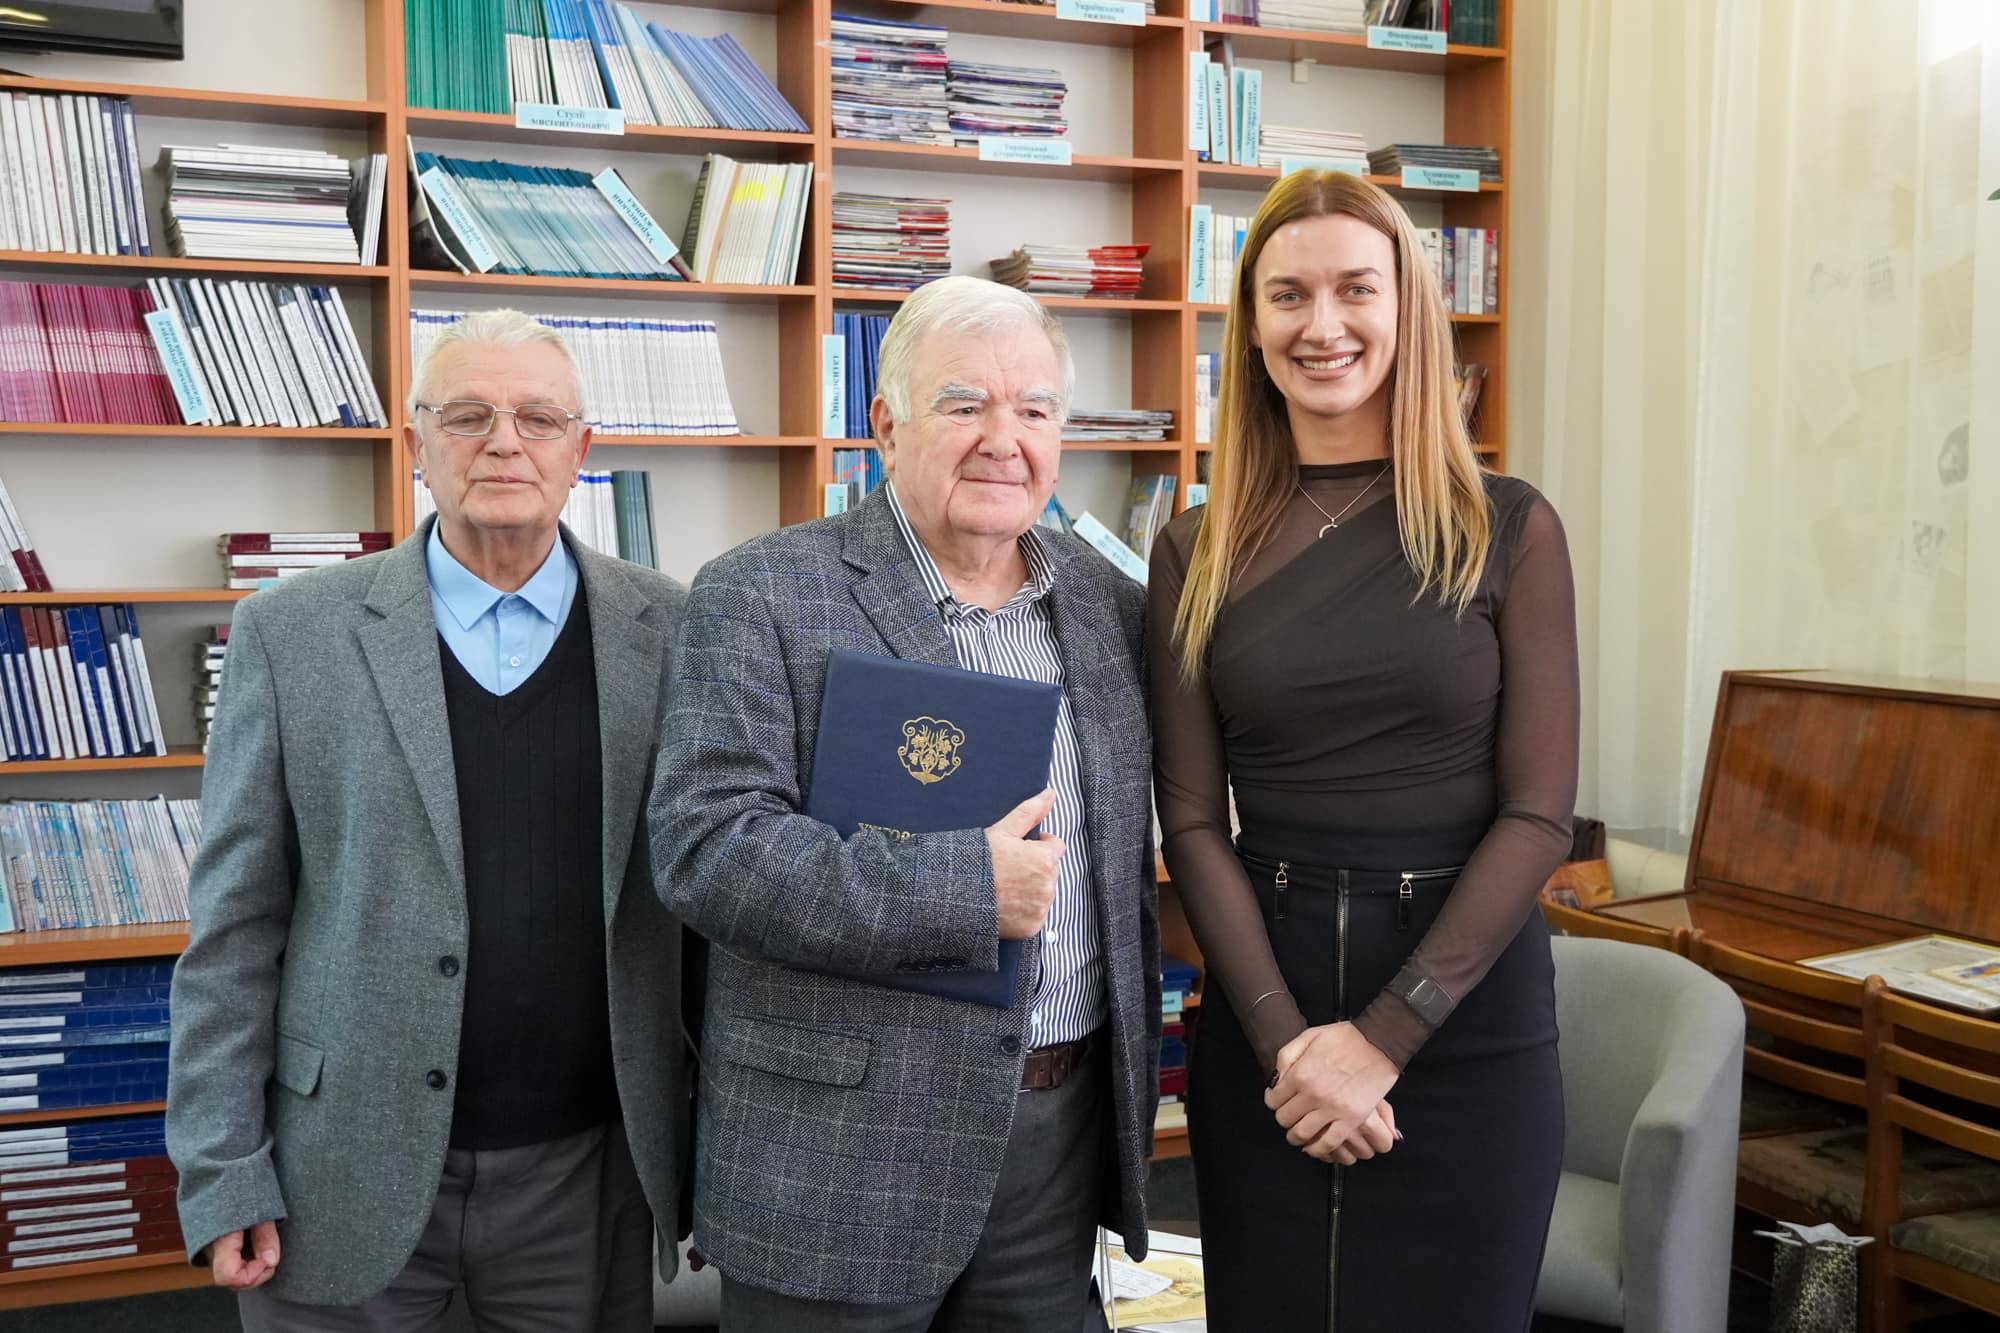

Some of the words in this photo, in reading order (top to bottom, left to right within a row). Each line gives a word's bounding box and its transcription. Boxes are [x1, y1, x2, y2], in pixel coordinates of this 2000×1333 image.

[611, 192, 655, 244] Український
[626, 197, 653, 227] журнал
[1195, 220, 1205, 289] Хроніка-2000
